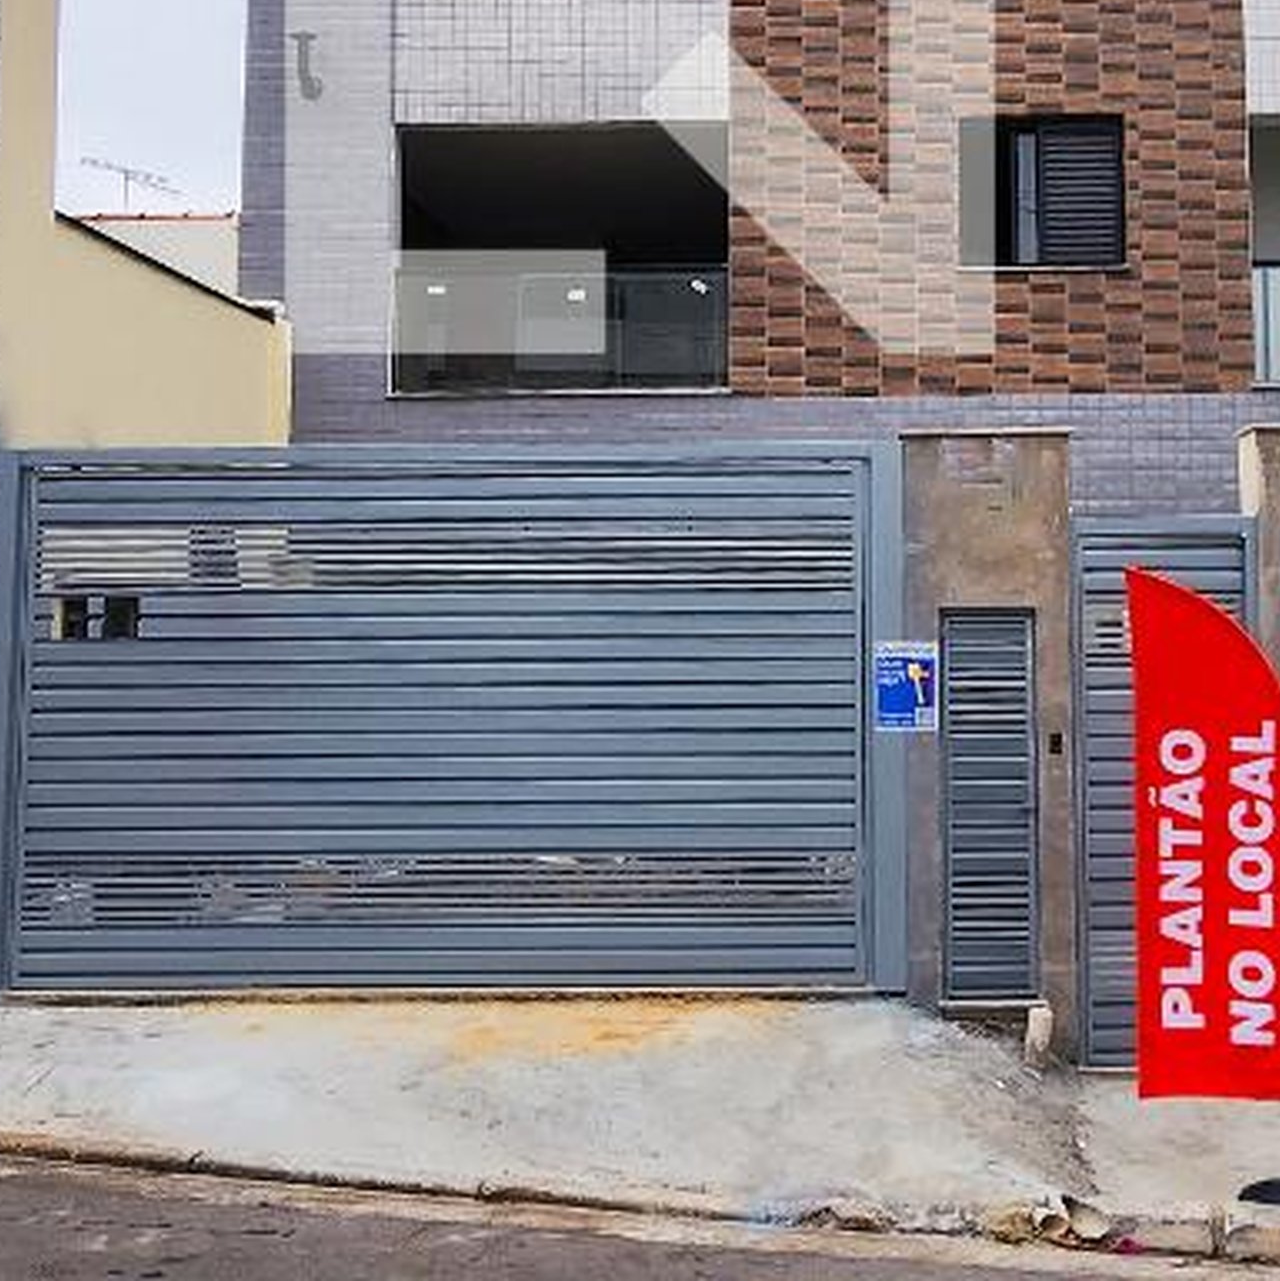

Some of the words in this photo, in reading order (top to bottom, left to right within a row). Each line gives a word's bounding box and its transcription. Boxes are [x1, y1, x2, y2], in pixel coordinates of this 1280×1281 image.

[1148, 727, 1208, 1030] PLANTÃO
[1228, 719, 1277, 929] LOCAL
[1228, 949, 1277, 1047] NO
